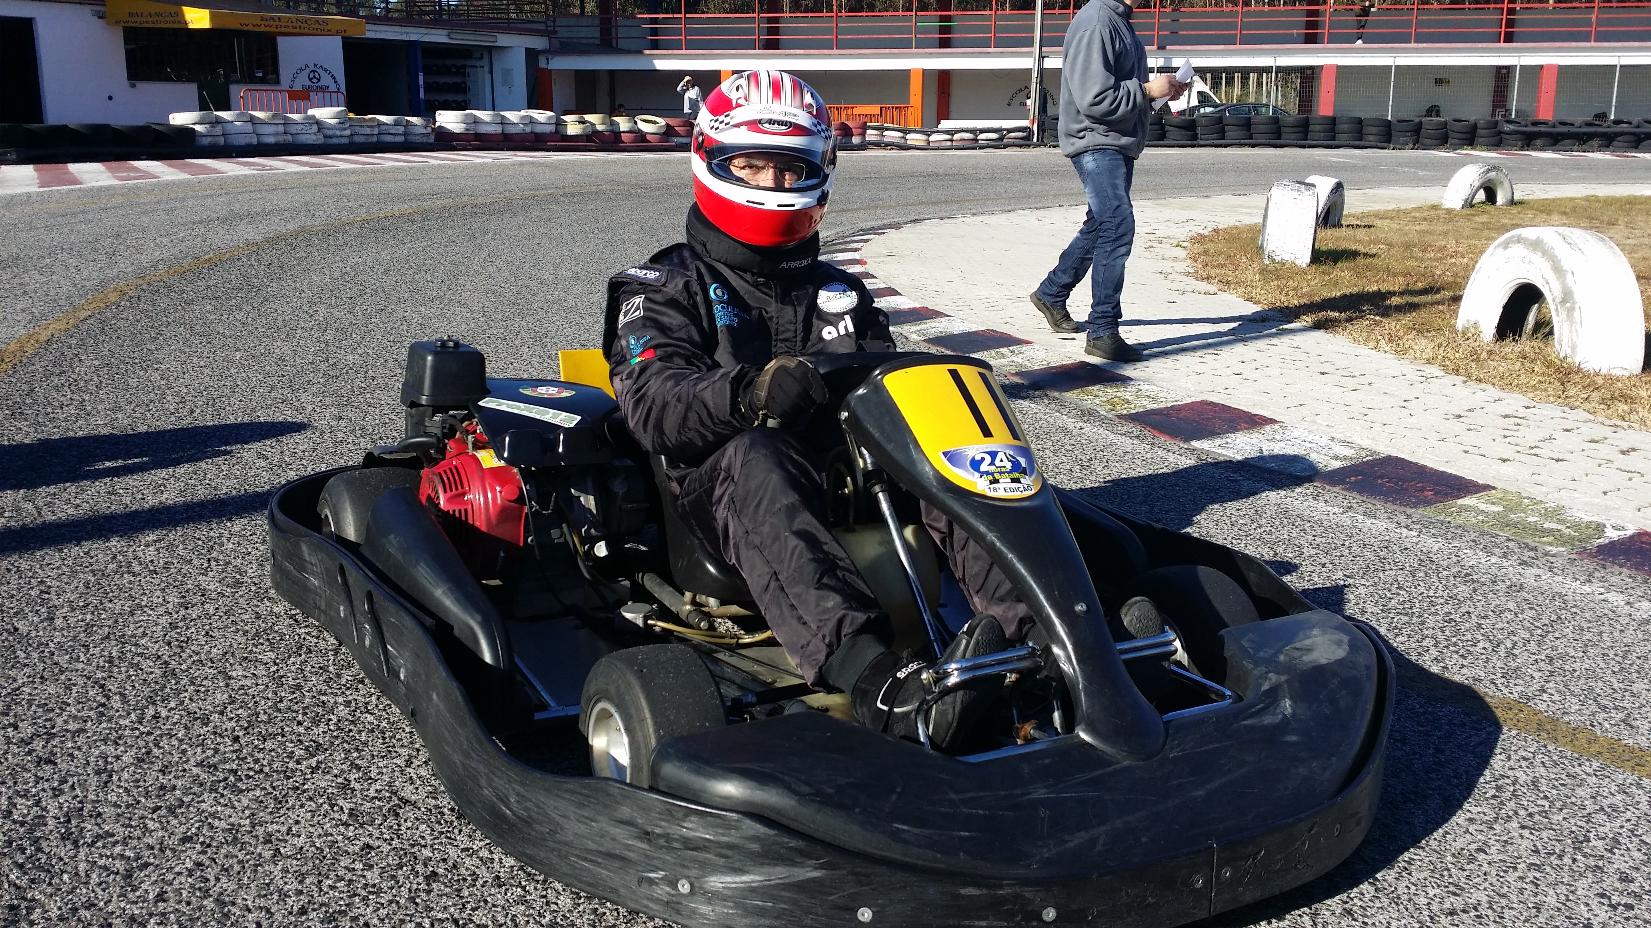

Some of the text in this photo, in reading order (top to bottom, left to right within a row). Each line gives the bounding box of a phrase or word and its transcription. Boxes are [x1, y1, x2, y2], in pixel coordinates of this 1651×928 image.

[240, 22, 347, 35] www.pestronix.pt
[288, 63, 310, 90] ESCOLA
[1006, 85, 1030, 107] ESCOLA
[974, 451, 1013, 472] 24
[1003, 484, 1033, 494] EDIÇÃO
